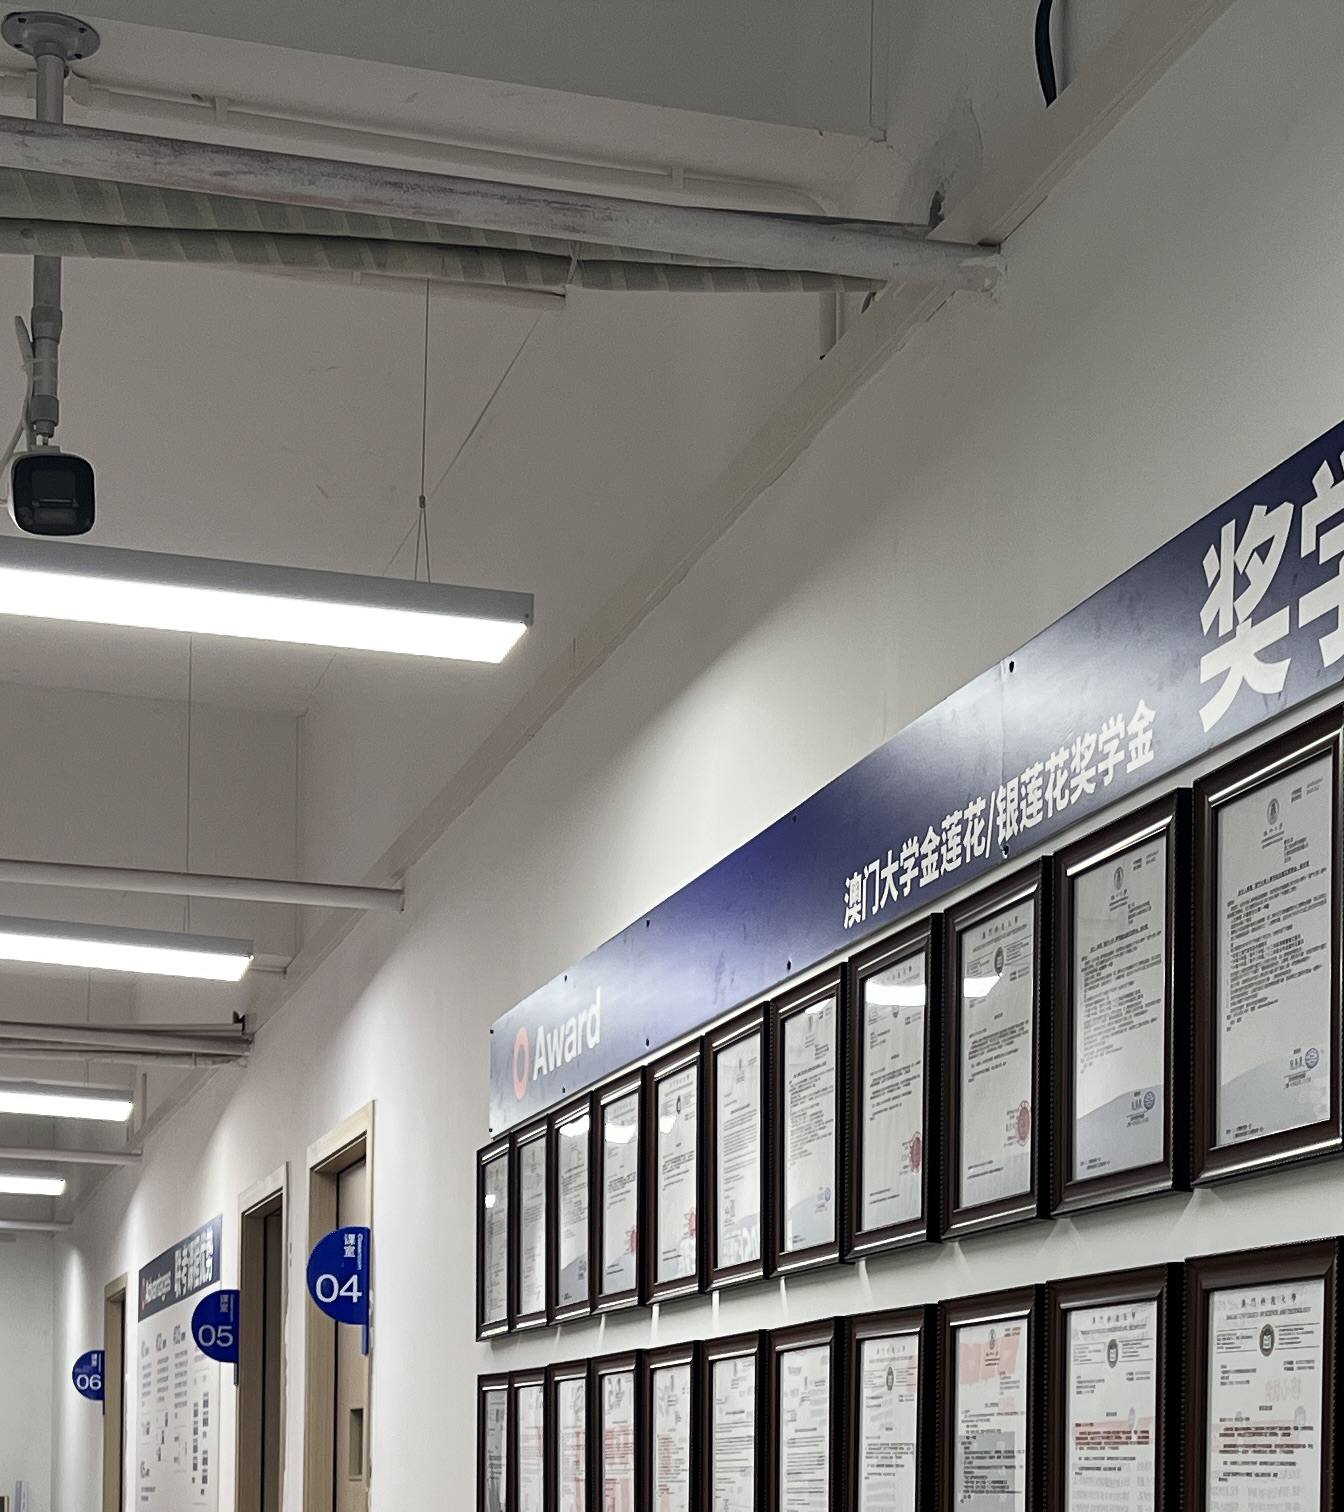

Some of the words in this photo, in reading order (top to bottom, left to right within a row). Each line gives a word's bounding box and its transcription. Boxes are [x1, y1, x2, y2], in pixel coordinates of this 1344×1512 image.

[843, 698, 1157, 930] 澳门大学金莲花/银莲花奖学金
[533, 987, 602, 1082] Award
[316, 1273, 363, 1303] 04
[198, 1324, 234, 1347] 05
[76, 1373, 102, 1390] 06
